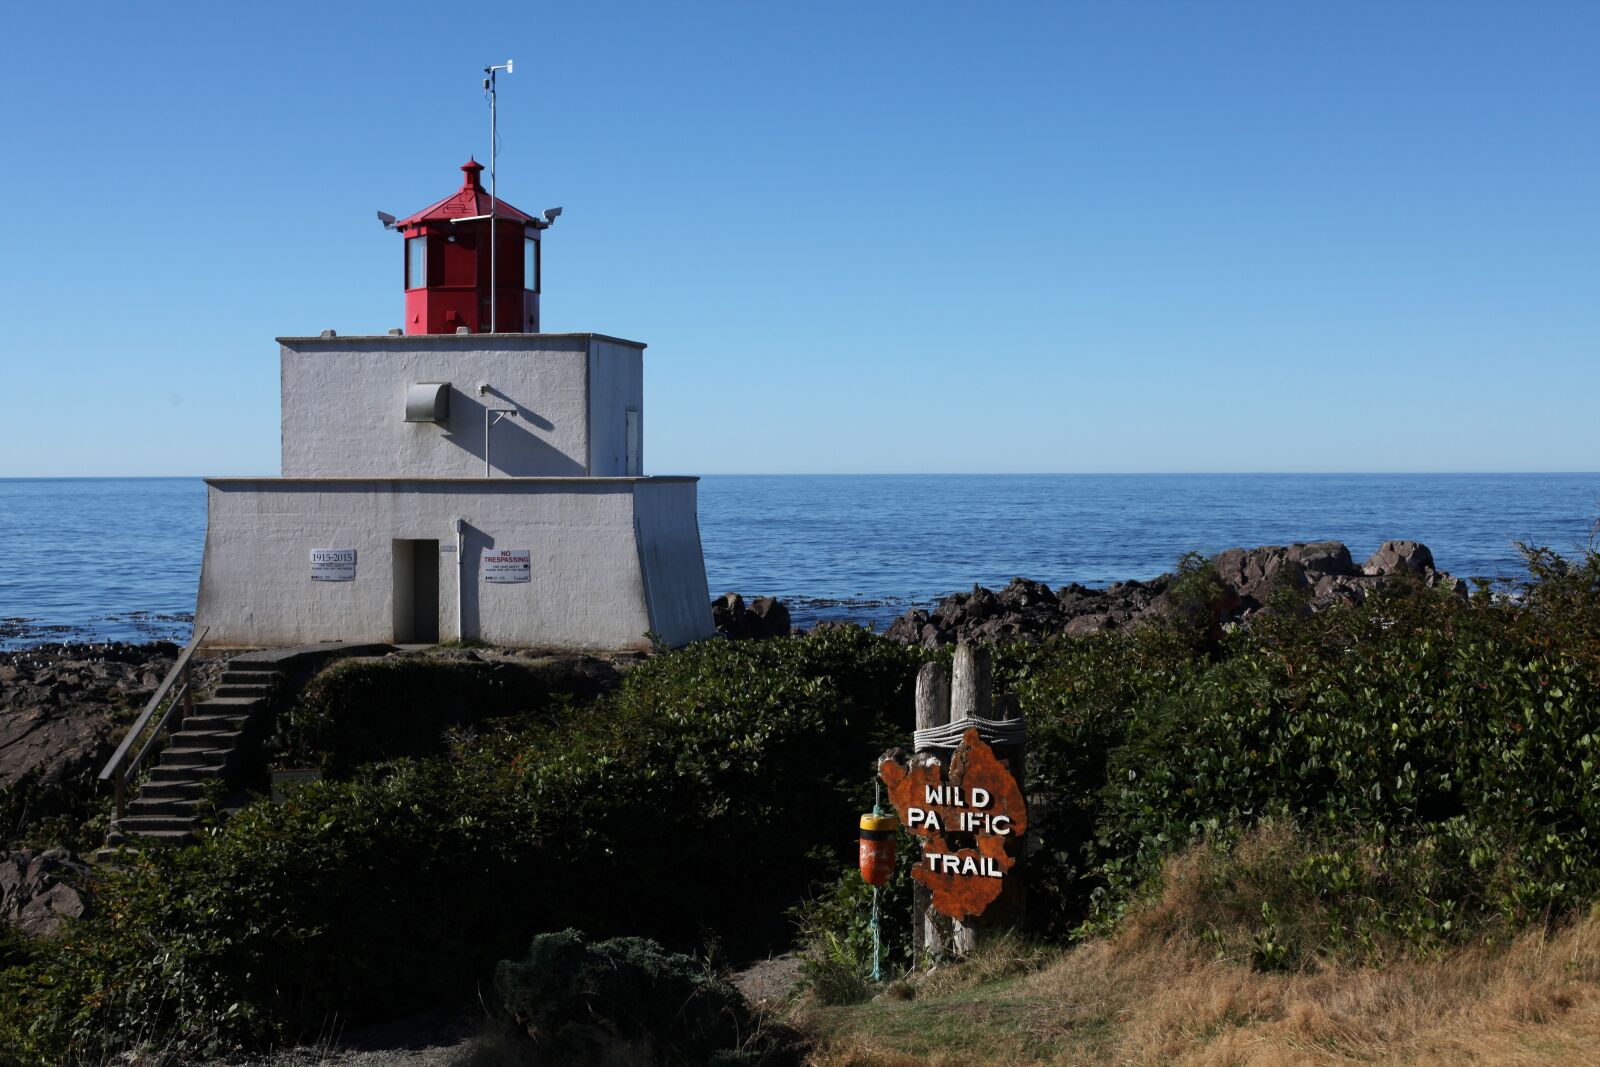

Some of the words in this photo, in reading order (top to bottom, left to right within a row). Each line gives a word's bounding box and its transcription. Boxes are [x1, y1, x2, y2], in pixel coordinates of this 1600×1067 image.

[312, 554, 352, 562] 1915-2015
[926, 784, 990, 808] WILD
[907, 808, 1010, 835] PAIFIC
[926, 853, 1003, 878] TRAIL
